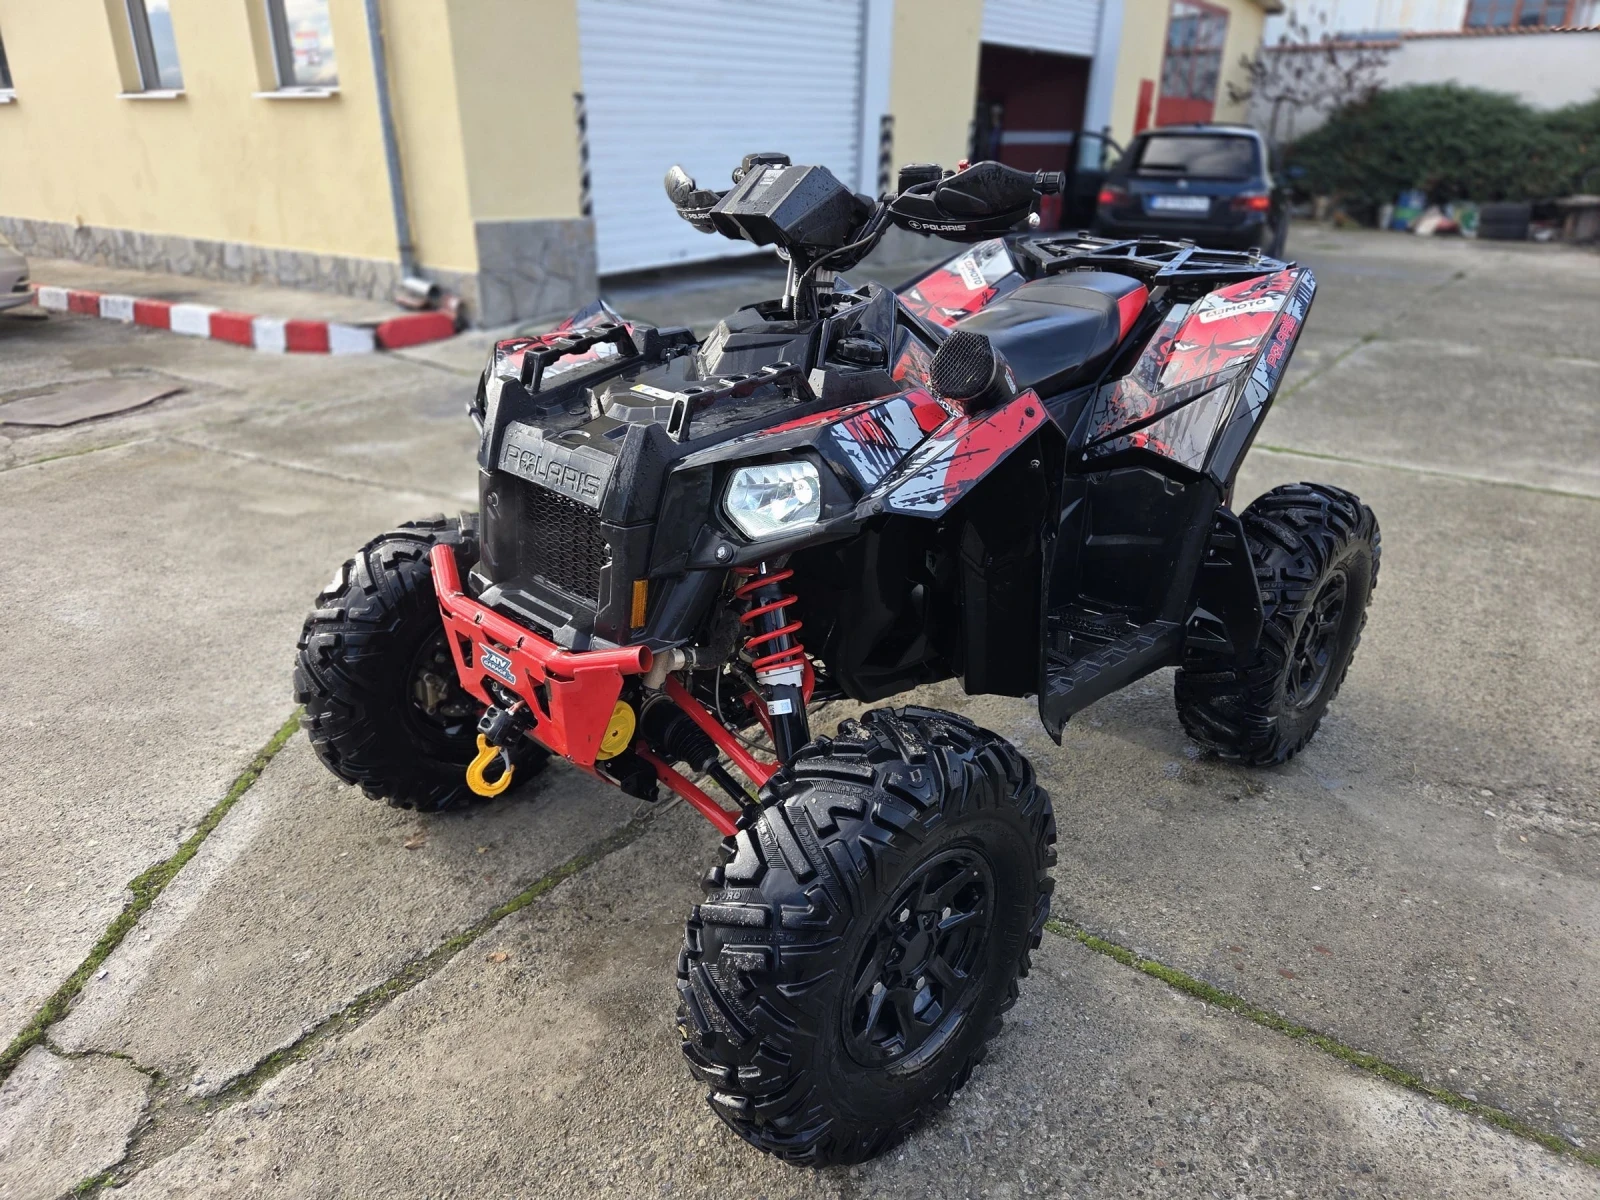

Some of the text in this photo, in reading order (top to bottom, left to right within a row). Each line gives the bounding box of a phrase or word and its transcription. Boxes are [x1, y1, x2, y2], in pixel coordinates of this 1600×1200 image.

[922, 223, 966, 231] POLARIS
[1266, 313, 1297, 368] POLARIS
[504, 443, 601, 497] POLARIS
[483, 660, 506, 675] GARAGE
[490, 654, 506, 667] ATV
